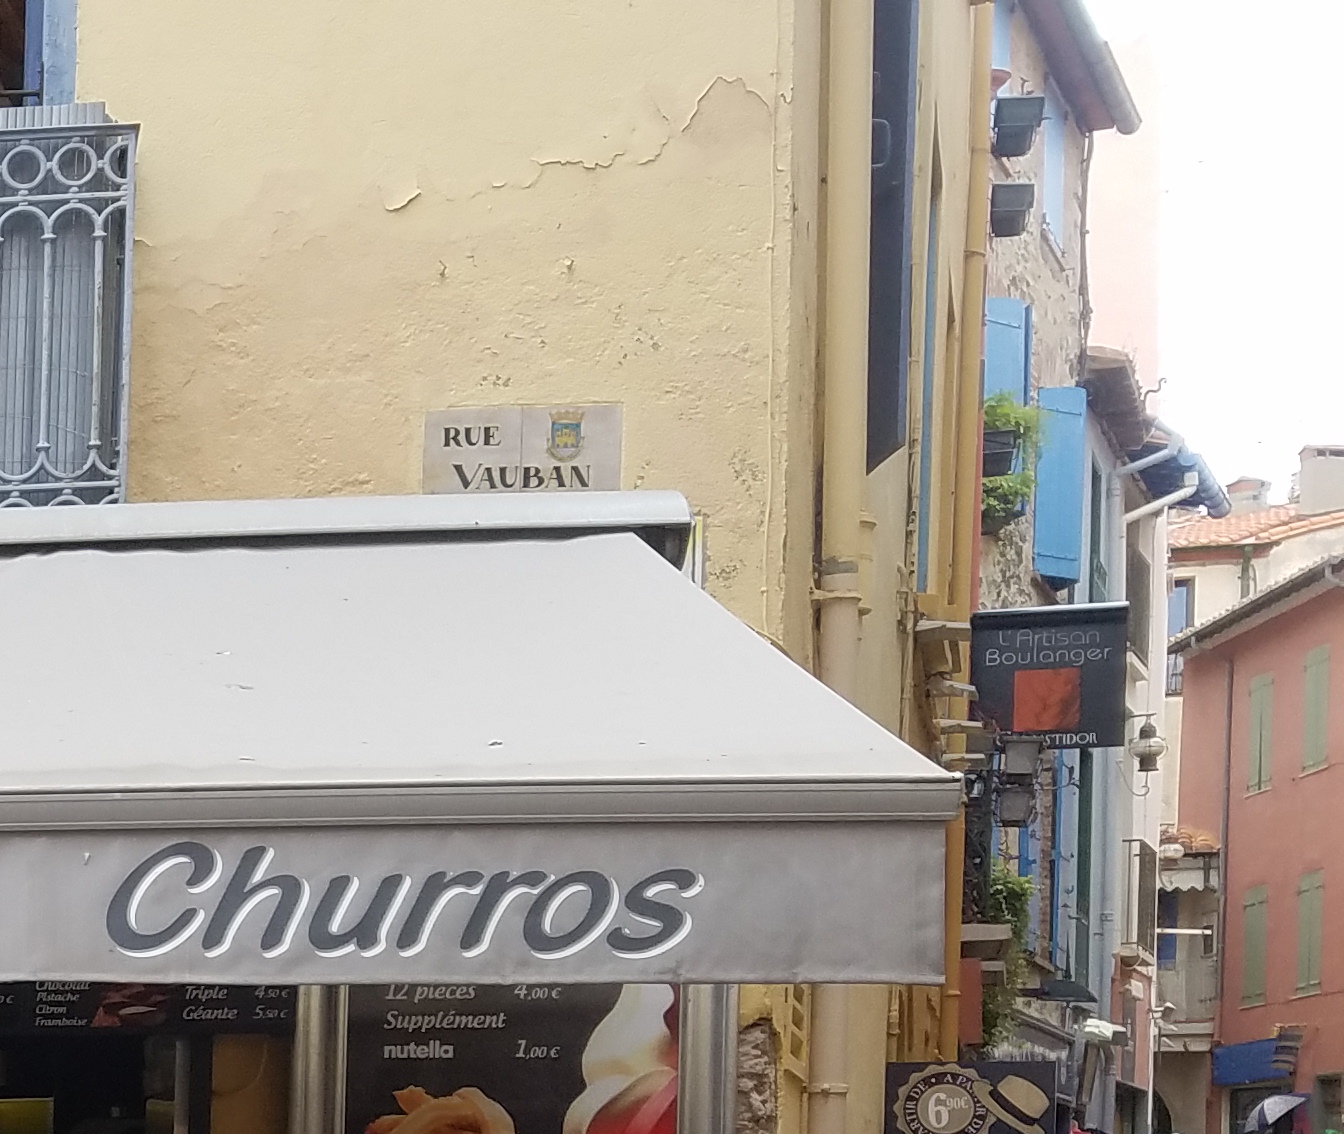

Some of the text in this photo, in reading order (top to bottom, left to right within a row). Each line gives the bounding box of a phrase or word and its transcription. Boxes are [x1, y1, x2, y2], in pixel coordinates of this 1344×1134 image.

[443, 426, 502, 448] RUE
[452, 463, 590, 490] VAUBAN
[998, 629, 1100, 648] L'Artisan
[985, 642, 1112, 666] Boulanger
[1022, 732, 1097, 746] STIDOR
[105, 840, 705, 960] Churros
[37, 991, 80, 1002] Pistache
[184, 985, 228, 1001] Triple
[385, 984, 410, 1000] 12
[35, 1004, 67, 1014] Citron
[182, 1004, 238, 1020] Géante
[34, 1016, 88, 1027] Framboise
[383, 1010, 507, 1033] Supplément
[384, 1039, 454, 1059] nutella
